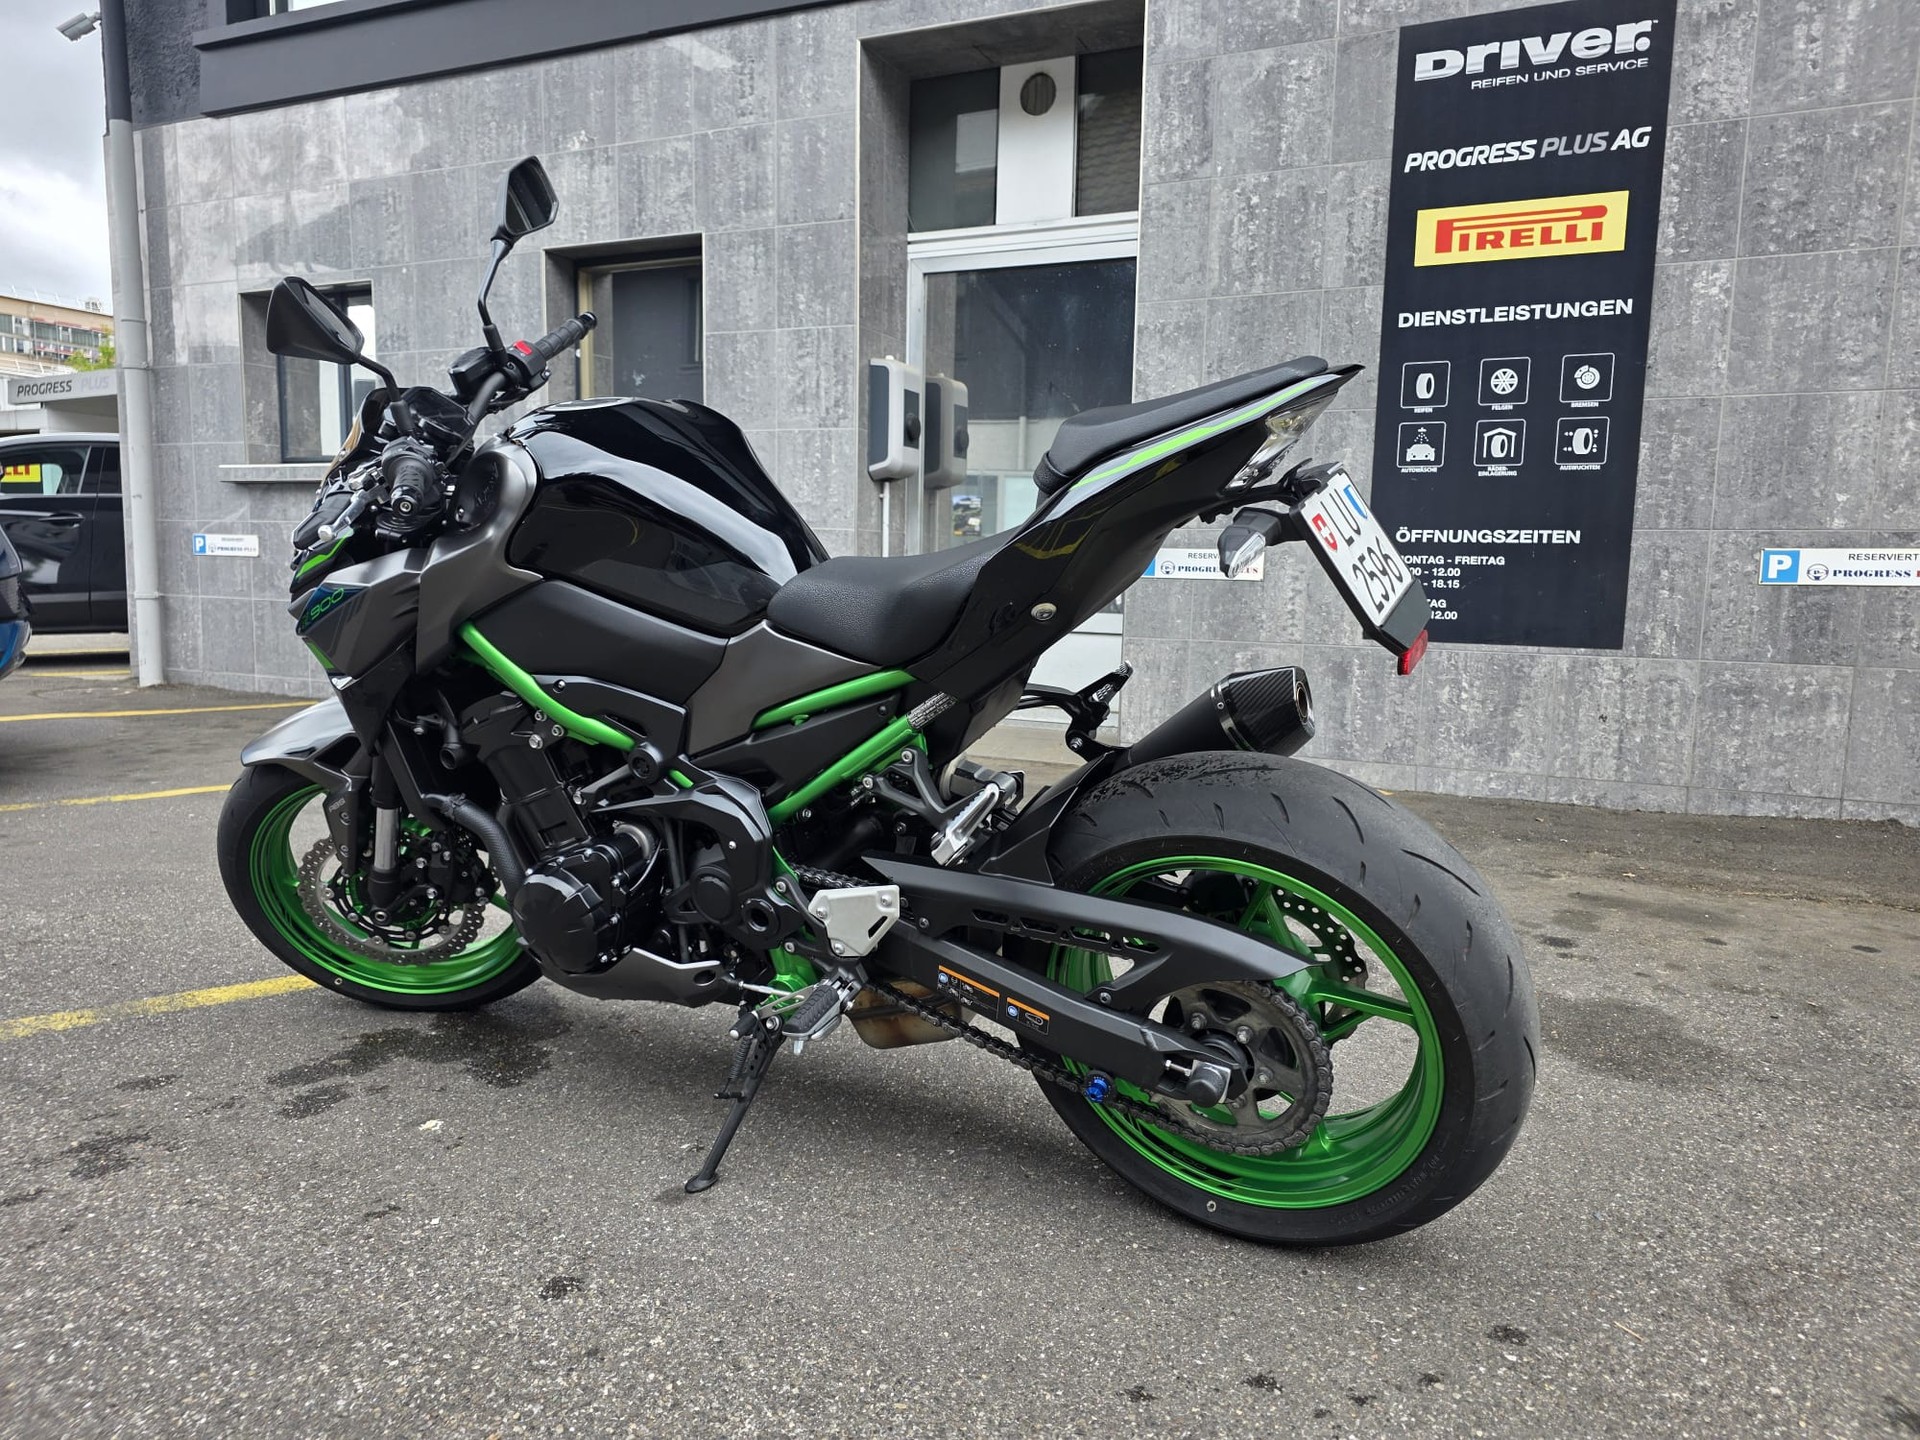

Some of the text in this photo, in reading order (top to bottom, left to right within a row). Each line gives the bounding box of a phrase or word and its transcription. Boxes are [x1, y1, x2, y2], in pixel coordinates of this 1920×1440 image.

[1471, 58, 1649, 90] REIFEN UND SERVICE
[1404, 126, 1652, 173] PROGRESS PLUS AG
[1435, 204, 1608, 254] PIRELLI
[1398, 298, 1633, 328] DIENSTLEISTUNGEN
[17, 380, 72, 398] PROGRESS
[1320, 488, 1362, 547] LU
[1395, 527, 1580, 544] ÖFFNUNGSZEITEN
[1187, 552, 1219, 560] RESERV
[1454, 555, 1505, 566] FREITAG
[1848, 553, 1920, 561] RESERVIERT
[1352, 535, 1404, 614] 2596
[1431, 567, 1461, 577] 12.00
[1767, 554, 1793, 579] P
[1833, 569, 1912, 578] PROGRESS
[1430, 579, 1460, 589] 18.15
